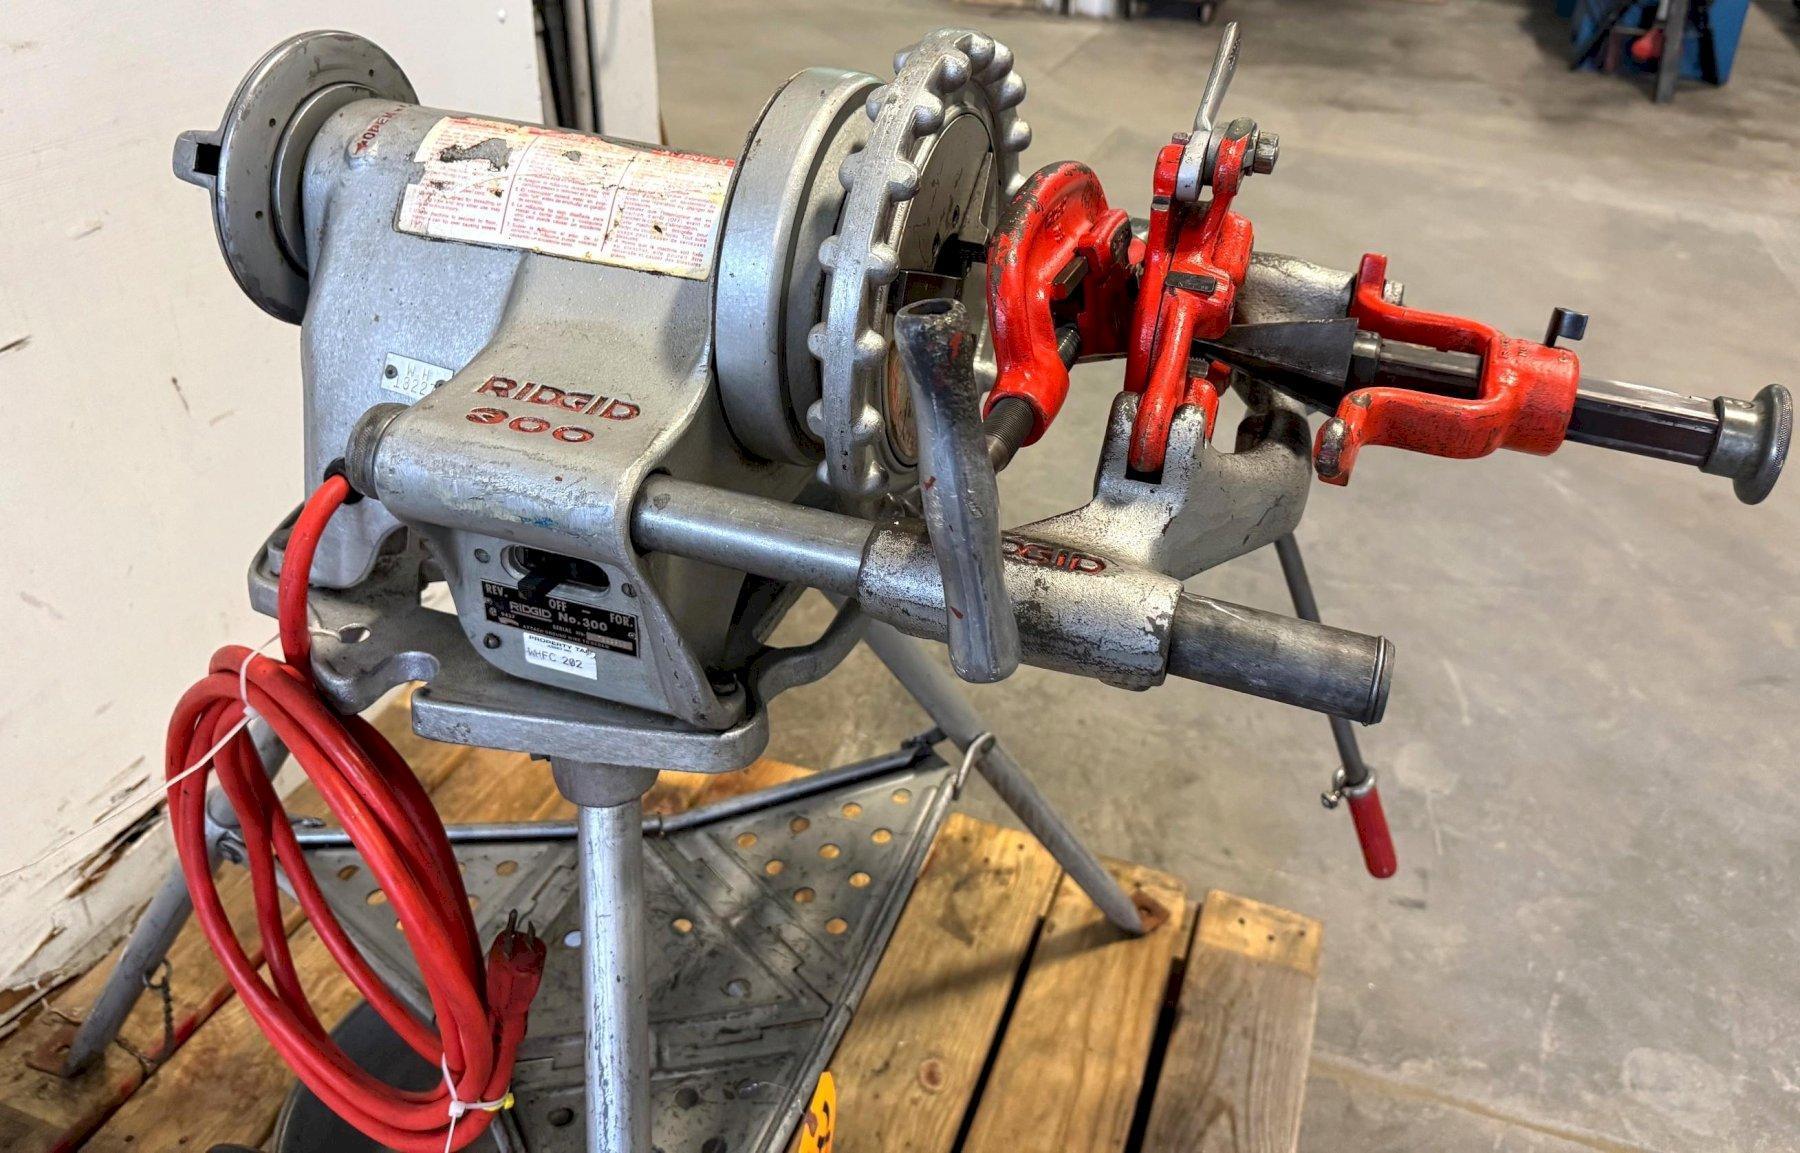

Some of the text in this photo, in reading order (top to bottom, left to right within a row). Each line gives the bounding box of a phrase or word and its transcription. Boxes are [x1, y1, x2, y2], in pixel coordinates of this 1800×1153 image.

[474, 375, 641, 421] RIDGID
[465, 407, 595, 443] 300
[1001, 537, 1106, 574] DGID
[485, 583, 634, 628] REV. OFF FOR.
[509, 600, 552, 620] RIDGID
[528, 634, 573, 650] PROPERTY
